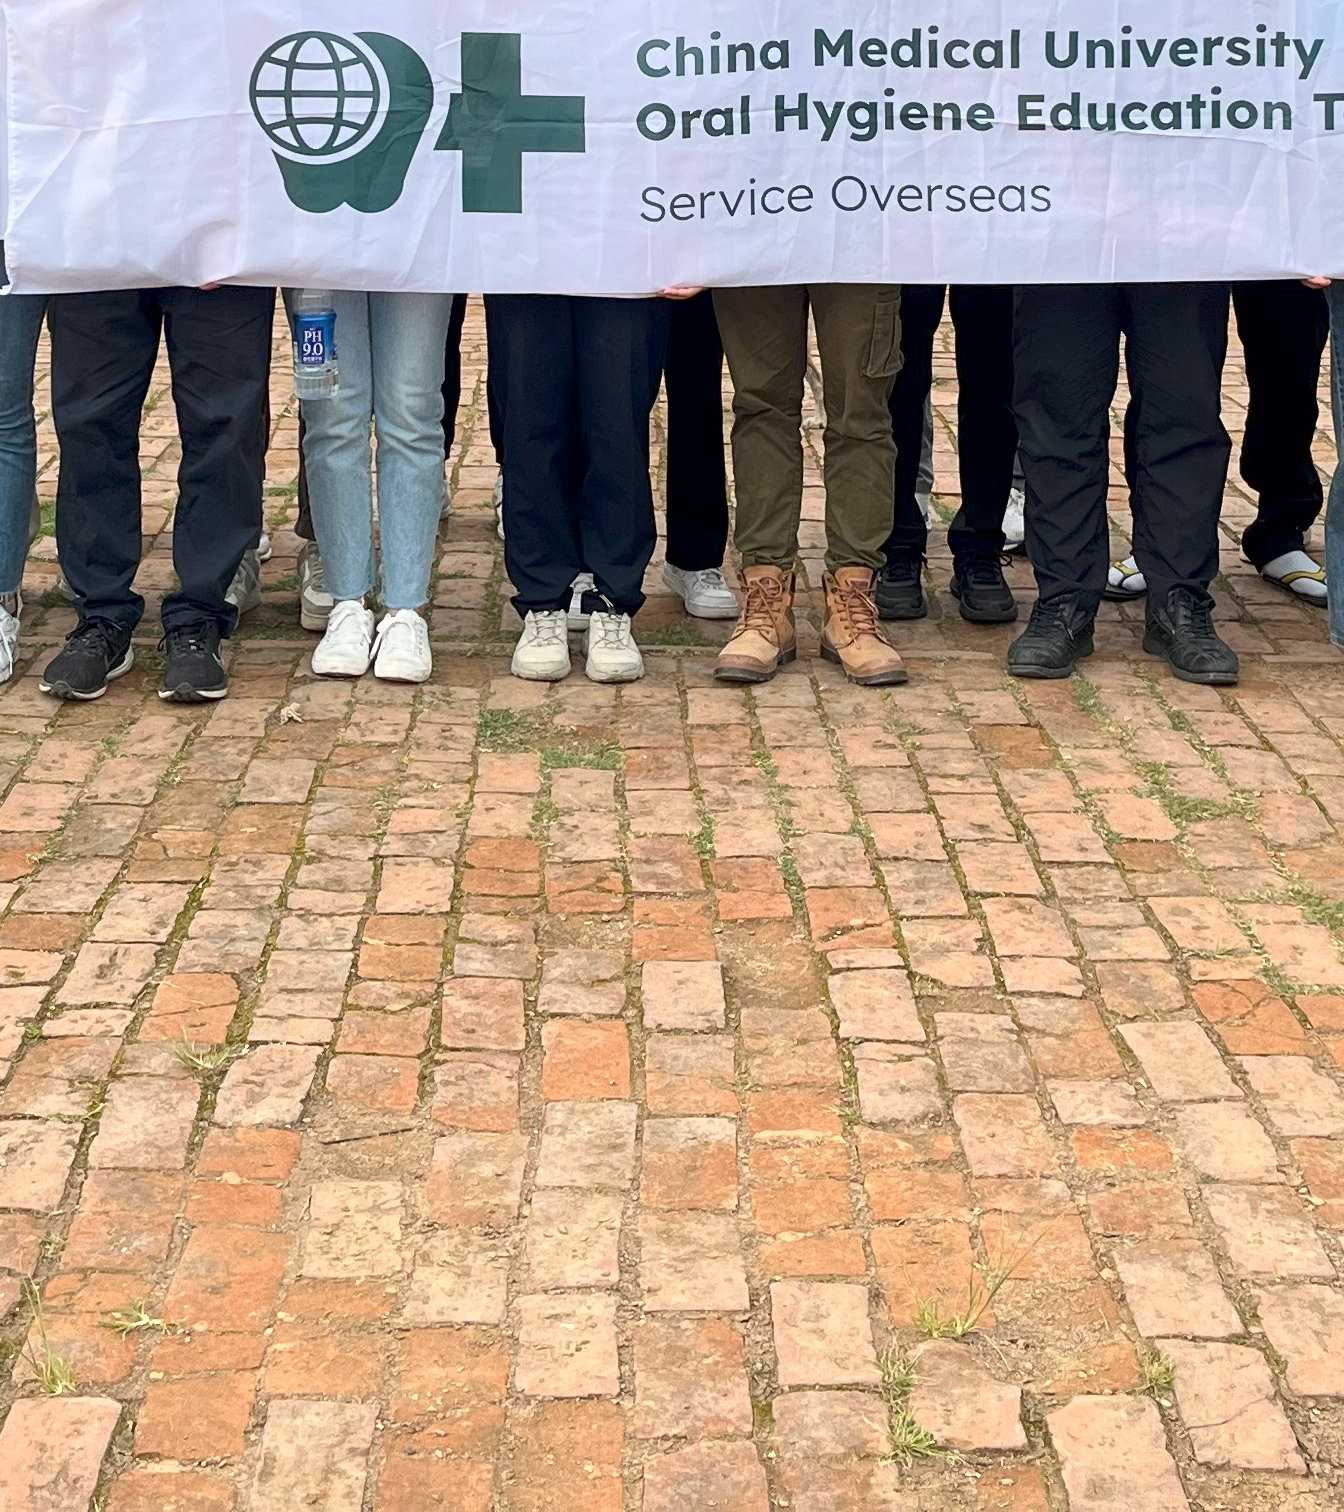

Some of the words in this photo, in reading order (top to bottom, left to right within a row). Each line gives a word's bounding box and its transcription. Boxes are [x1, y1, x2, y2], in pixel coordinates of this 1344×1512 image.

[636, 31, 790, 77] China
[814, 25, 1020, 69] Medical
[1044, 24, 1324, 80] University
[636, 95, 750, 141] Oral
[774, 88, 995, 142] Hygiene
[1017, 86, 1292, 132] Education
[640, 178, 814, 223] Service
[831, 175, 1052, 213] Overseas
[303, 343, 323, 356] 9.0
[304, 330, 322, 343] PH
